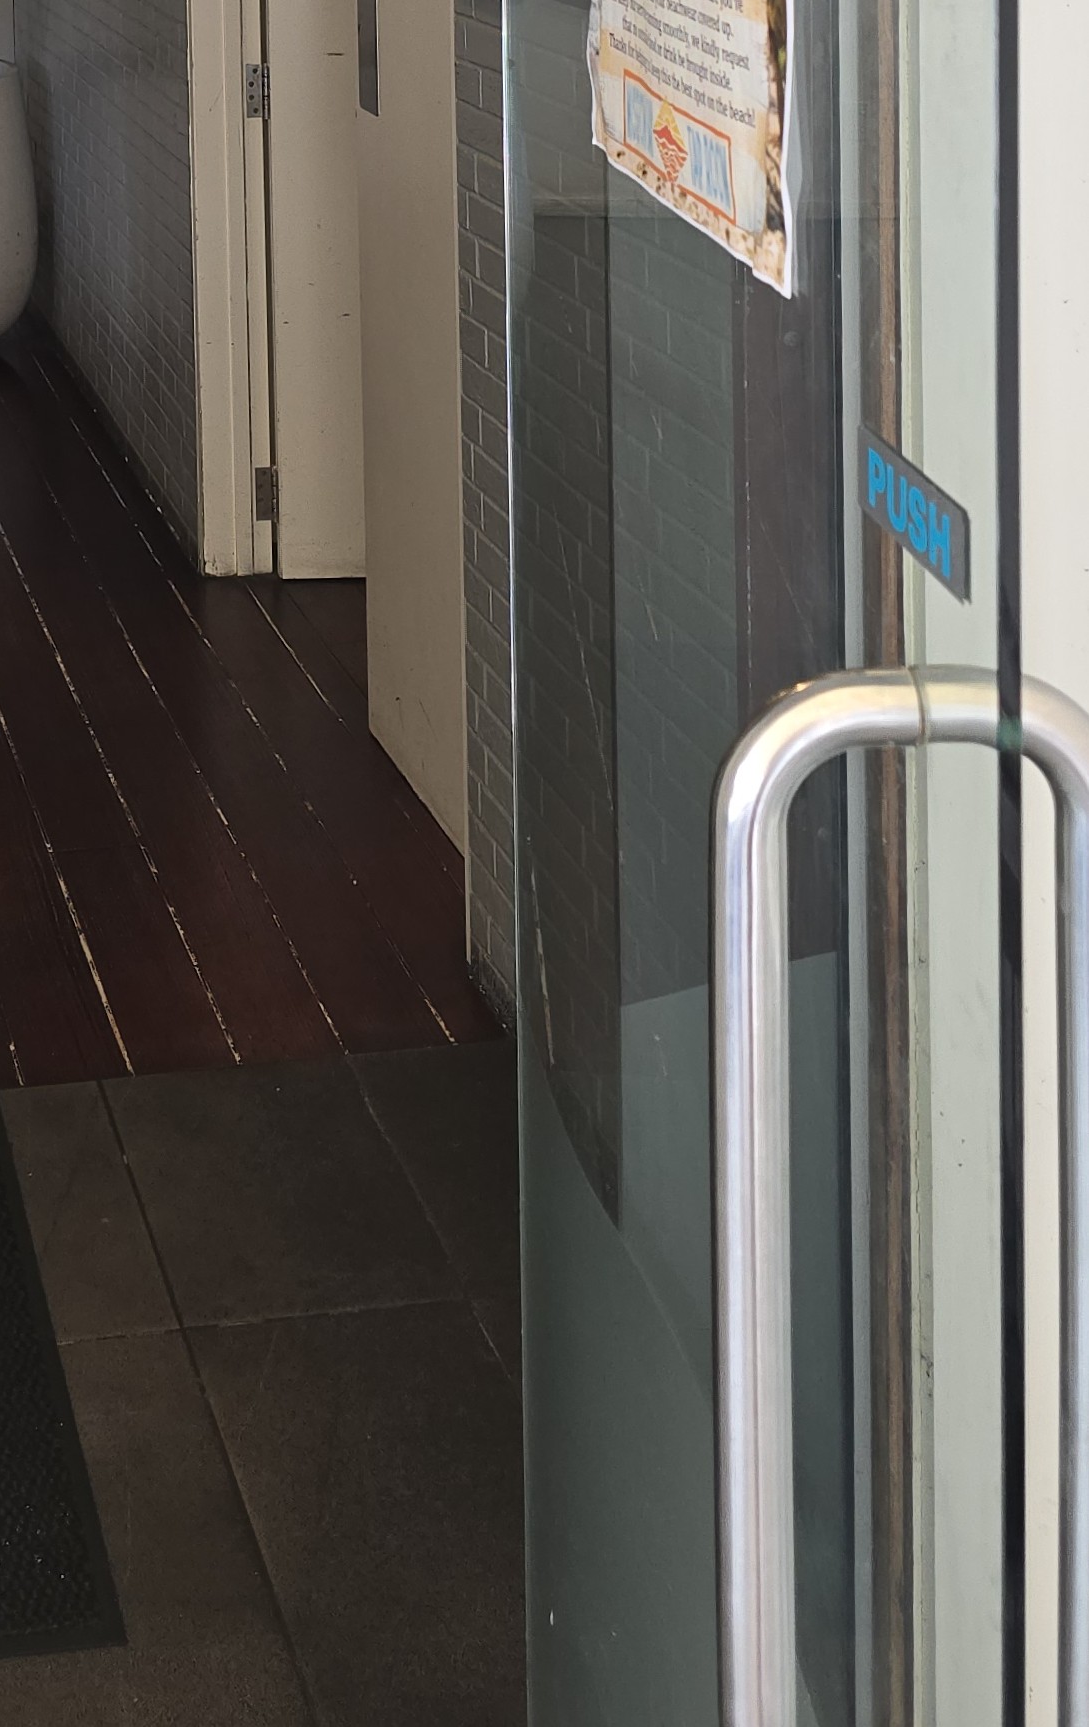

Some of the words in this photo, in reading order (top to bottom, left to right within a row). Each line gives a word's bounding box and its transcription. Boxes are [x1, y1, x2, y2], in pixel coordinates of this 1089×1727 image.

[663, 23, 690, 49] smoothly,
[691, 35, 700, 50] we
[701, 34, 719, 64] kindly
[722, 49, 750, 71] request
[698, 14, 720, 32] covered
[721, 21, 734, 41] up.
[609, 32, 627, 55] Thanks
[681, 76, 692, 98] best
[693, 88, 706, 107] spot
[707, 96, 715, 111] on
[716, 96, 728, 117] the
[729, 100, 756, 128] beach!
[663, 42, 677, 64] drink
[686, 53, 708, 82] brought
[709, 66, 733, 91] inside.
[868, 447, 950, 580] PUSH
